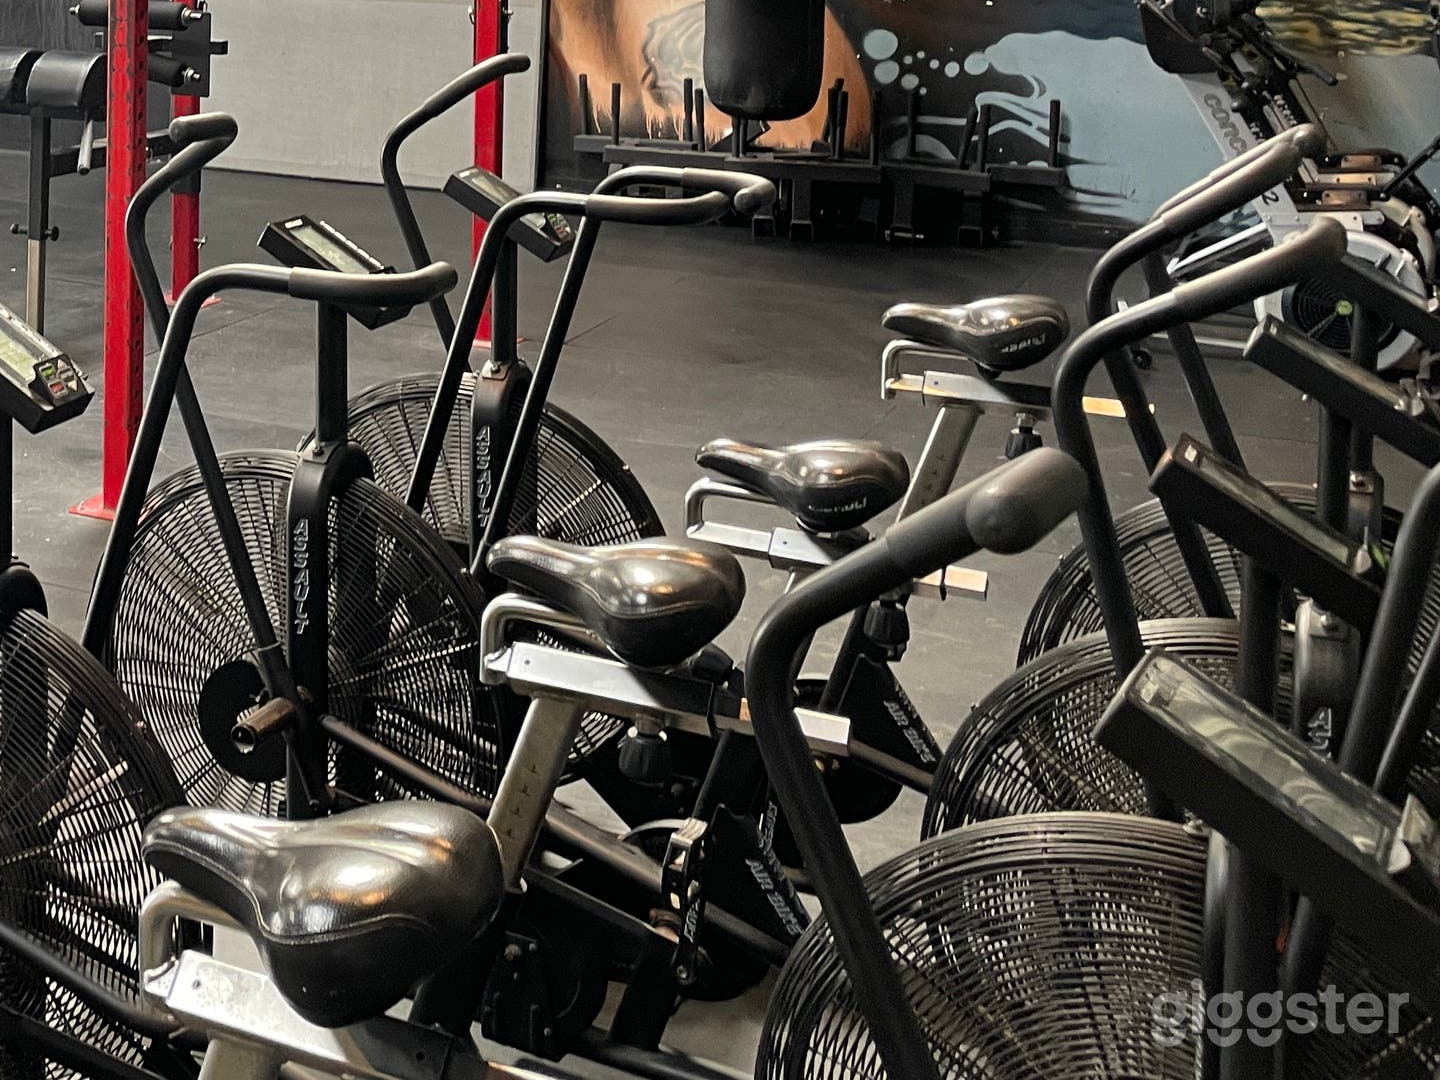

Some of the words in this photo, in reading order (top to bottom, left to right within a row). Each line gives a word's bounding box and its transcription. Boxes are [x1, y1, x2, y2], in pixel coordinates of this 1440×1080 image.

[1203, 93, 1248, 157] conc
[1261, 190, 1280, 206] 2
[475, 425, 492, 528] ASSAULT
[293, 519, 309, 634] ASSAULT
[744, 857, 774, 891] AIR
